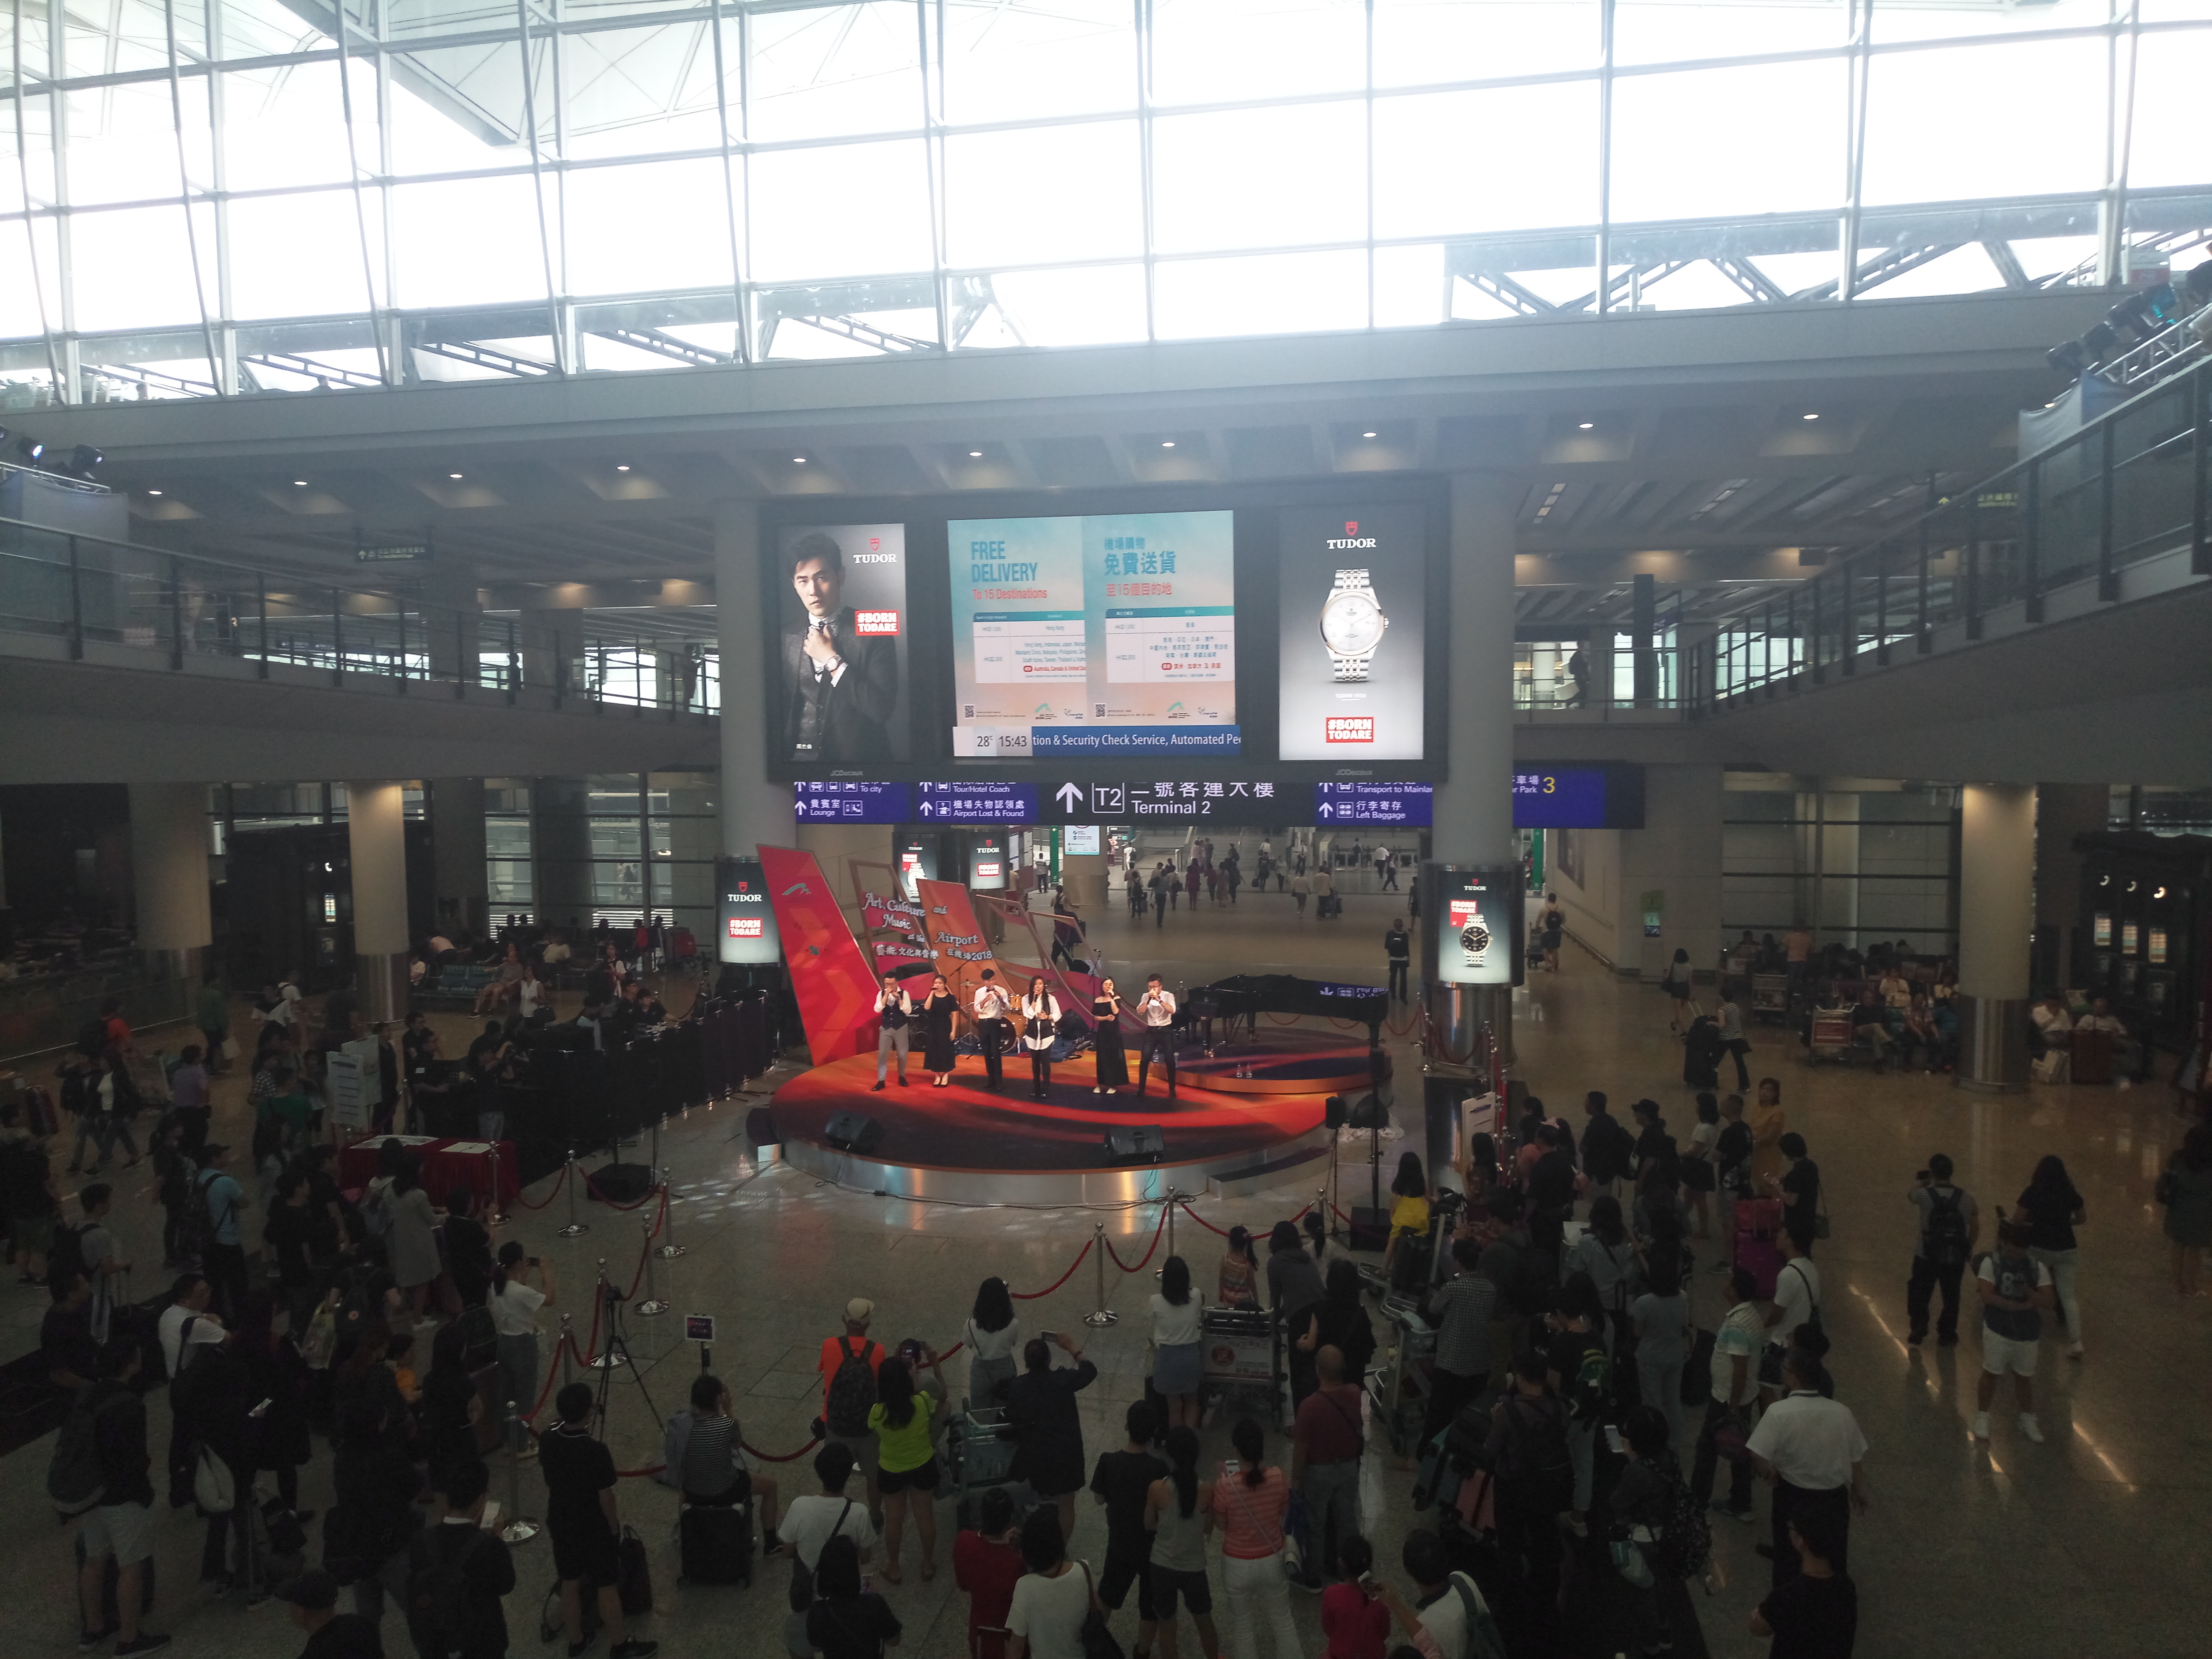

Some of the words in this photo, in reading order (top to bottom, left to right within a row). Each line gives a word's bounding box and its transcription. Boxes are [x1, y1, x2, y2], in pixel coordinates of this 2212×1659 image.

[1327, 538, 1377, 549] TUDOR
[971, 541, 1006, 560] FREE
[853, 554, 897, 563] TUDOR
[1104, 551, 1176, 575] 免費送貨
[971, 562, 1038, 582] DELIVERY
[973, 589, 982, 599] To
[984, 589, 994, 599] 15
[996, 588, 1047, 599] Destinations
[1106, 582, 1173, 596] 至15個目的地
[857, 612, 897, 623] #BORN
[1327, 719, 1372, 730] #BORN
[1032, 735, 1051, 745] tion
[1053, 735, 1061, 745] &
[1062, 735, 1100, 748] Security
[1102, 734, 1130, 745] Check
[1132, 734, 1168, 746] Service,
[1171, 733, 1224, 745] Automated
[1328, 730, 1372, 740] TODARE
[999, 735, 1027, 747] 15:43
[1356, 785, 1392, 794] Transport
[1512, 775, 1539, 785] 車場
[1542, 777, 1556, 793] 3
[1095, 787, 1122, 806] T2
[810, 799, 840, 809] 貴賓室
[953, 800, 1025, 809] 機場失物認領處
[1131, 800, 1196, 814] Terminal
[1201, 801, 1211, 814] 2
[1356, 801, 1402, 810] 行李寄存
[1372, 812, 1406, 820] Baggage
[887, 899, 926, 917] Culture
[932, 905, 947, 914] and
[730, 919, 761, 929] #BORN
[882, 914, 912, 930] Music
[934, 931, 979, 948] Airport
